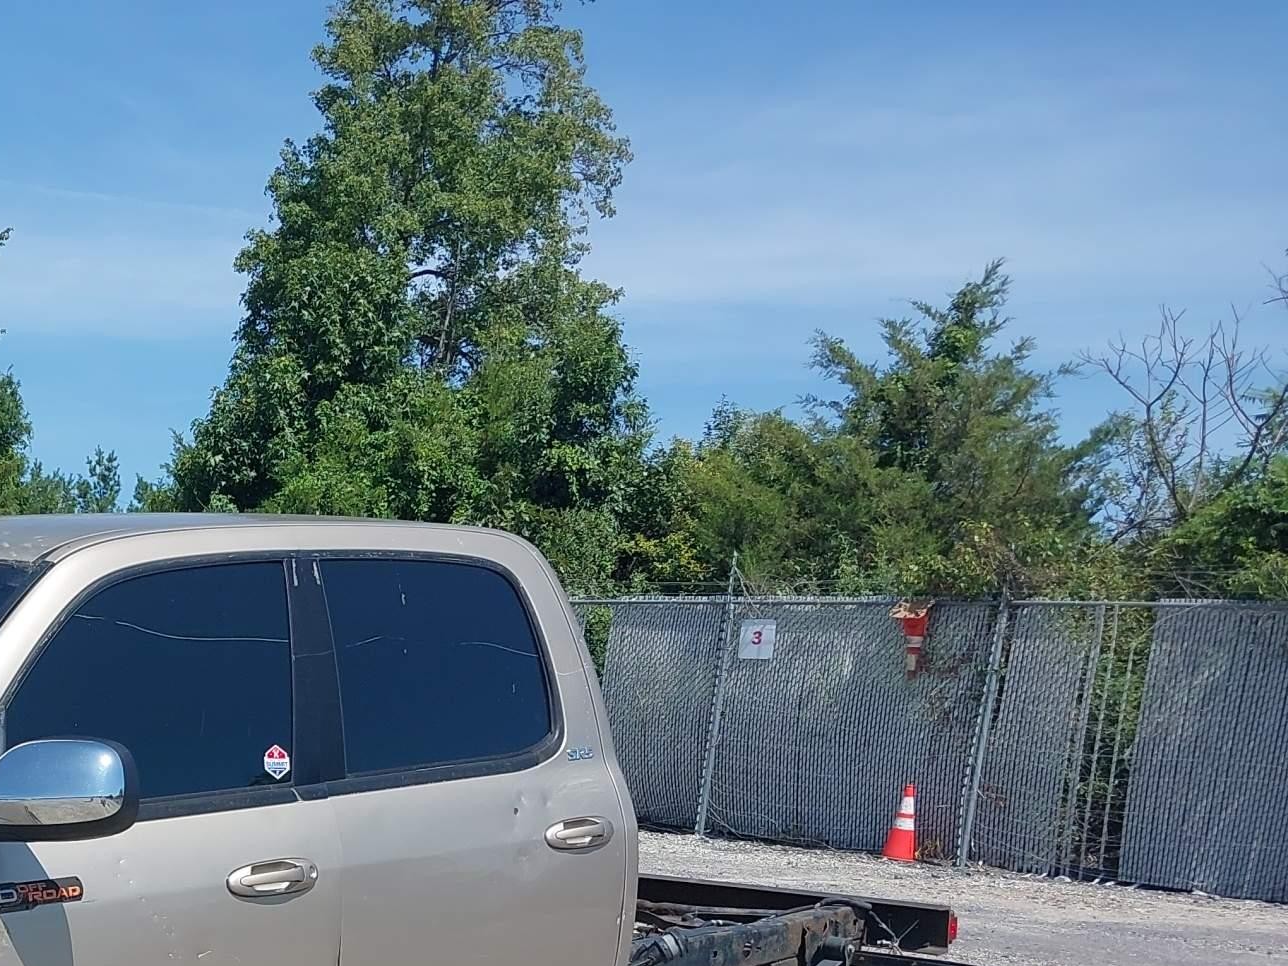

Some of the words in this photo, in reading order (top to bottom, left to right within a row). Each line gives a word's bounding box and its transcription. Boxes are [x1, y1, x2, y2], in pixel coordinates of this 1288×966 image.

[751, 630, 763, 645] 3
[16, 882, 47, 894] OFF
[26, 885, 82, 903] ROAD
